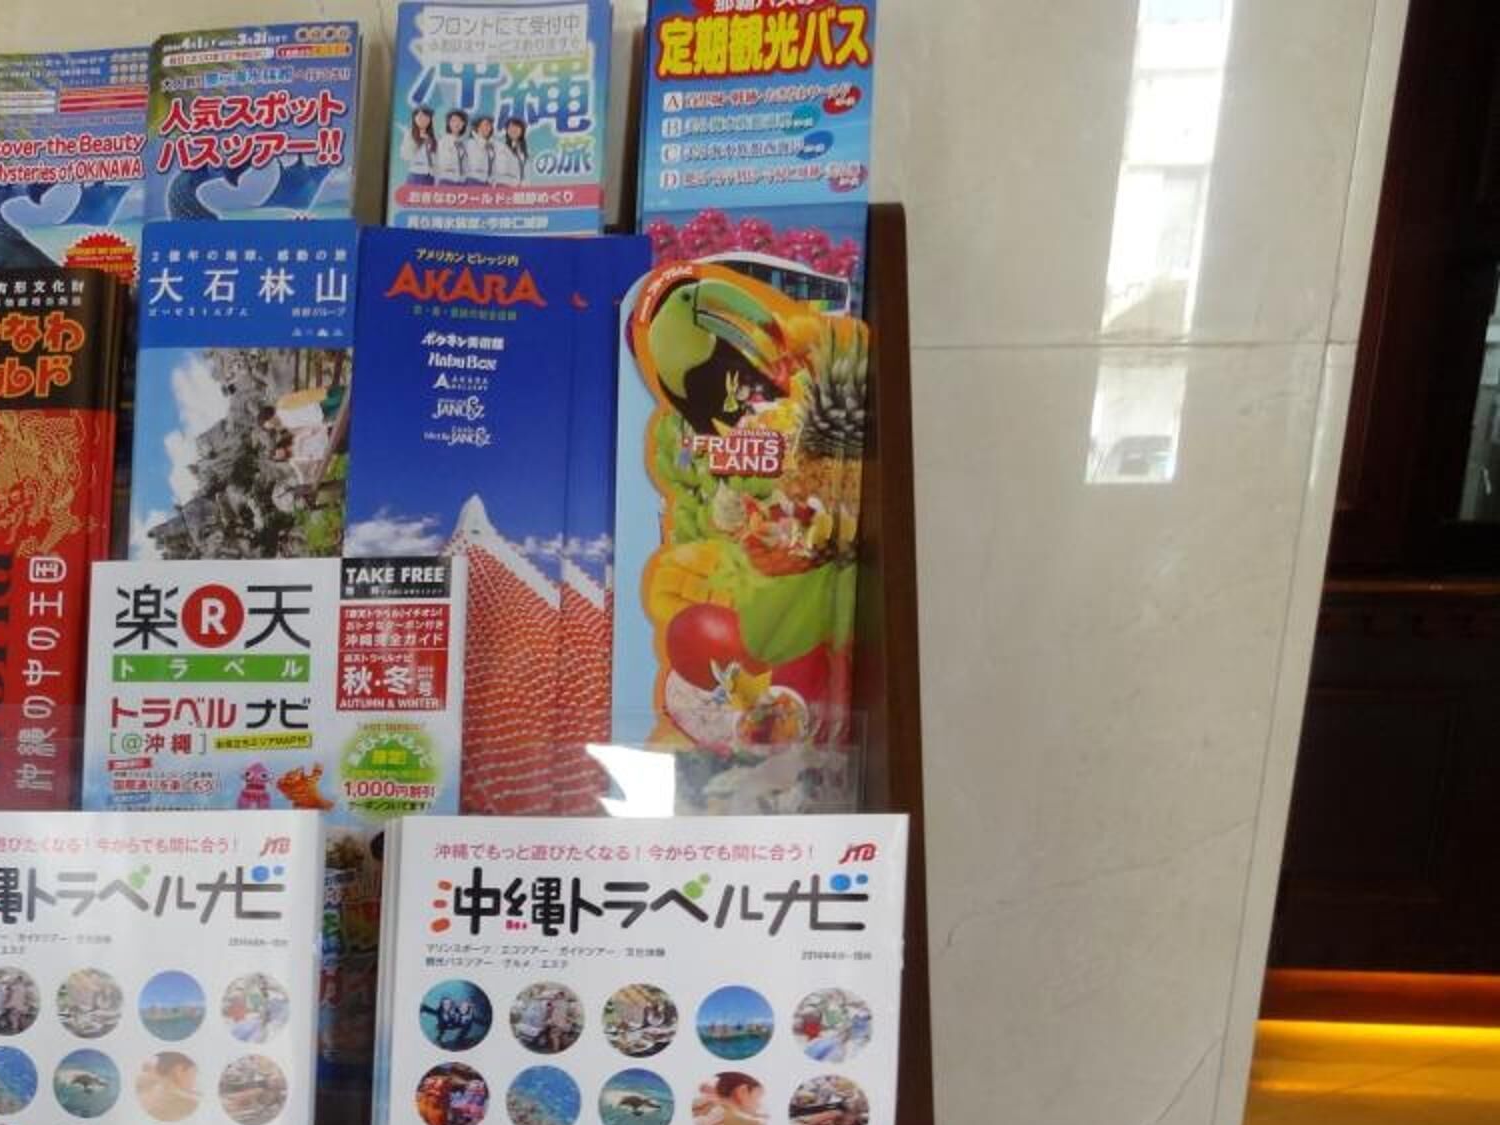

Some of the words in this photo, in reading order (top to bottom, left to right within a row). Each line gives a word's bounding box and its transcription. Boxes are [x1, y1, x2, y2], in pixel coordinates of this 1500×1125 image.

[657, 6, 869, 77] 定期観光バス
[160, 90, 346, 135] 人気スポット
[46, 138, 76, 156] the
[78, 134, 146, 154] Beauty
[157, 129, 343, 174] バスツアー!!
[75, 159, 145, 180] OKINAWA
[147, 266, 348, 305] 大石林山
[384, 261, 548, 307] AKARA
[693, 434, 780, 456] FRUITS
[708, 454, 780, 473] LAND
[340, 567, 395, 584] TAKE
[400, 566, 446, 584] FREE
[118, 659, 304, 680] トラベル
[110, 696, 237, 730] トラベル
[245, 696, 313, 730] ナビ
[339, 698, 386, 710] AUTUMN
[398, 698, 440, 710] WINTER
[429, 866, 870, 937] 沖縄トラベルナビ
